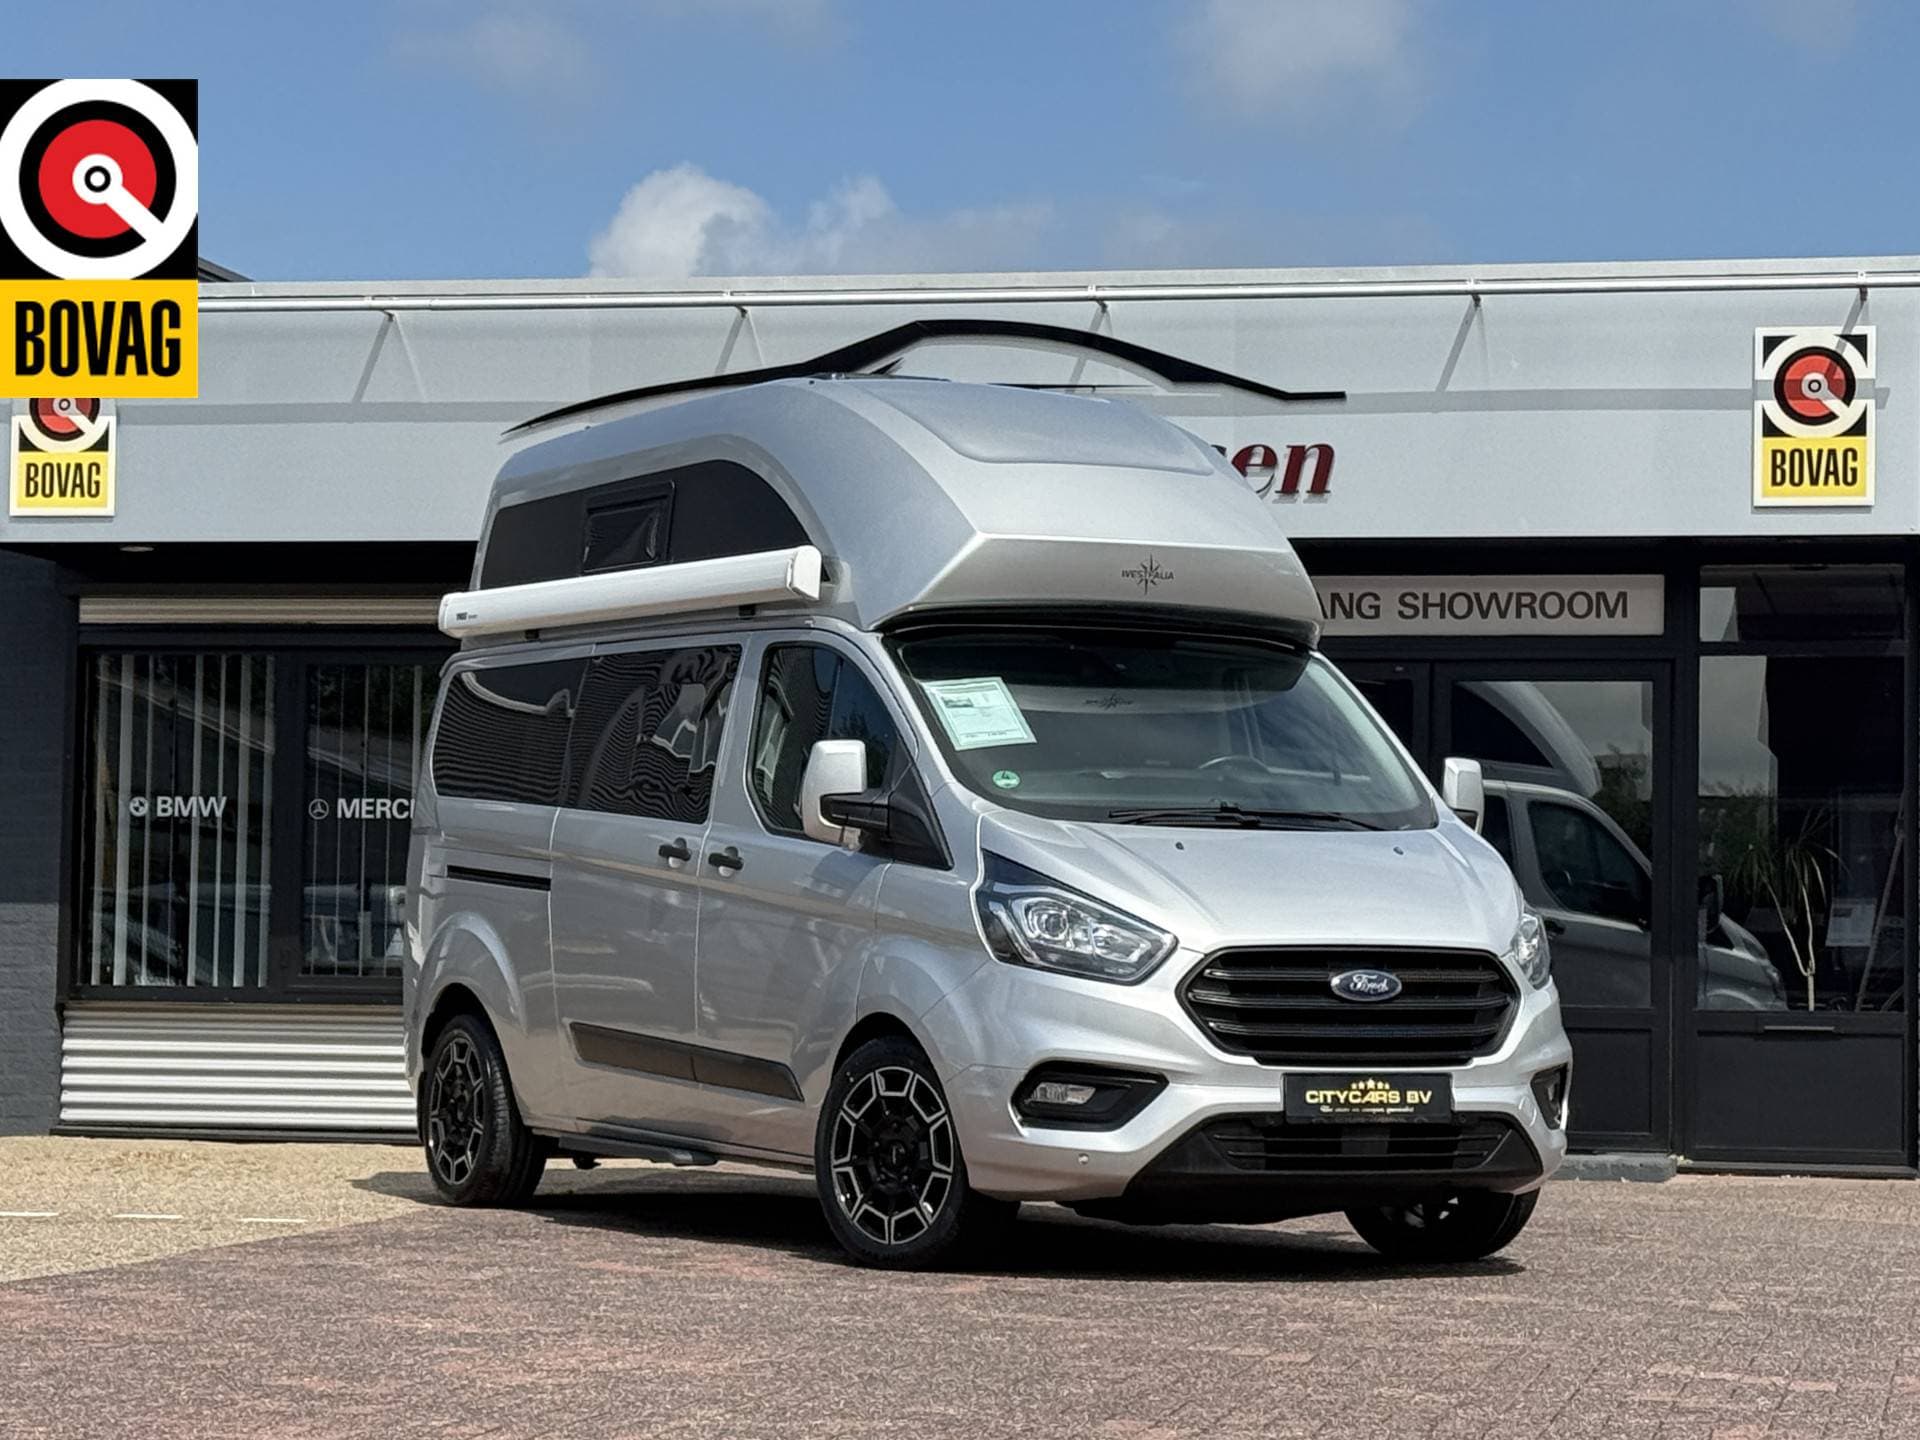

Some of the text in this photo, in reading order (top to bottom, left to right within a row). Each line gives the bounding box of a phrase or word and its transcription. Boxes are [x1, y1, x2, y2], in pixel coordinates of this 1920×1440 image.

[1771, 447, 1858, 487] BOVAG
[25, 462, 101, 498] BOVAG
[1398, 591, 1628, 620] SHOWROOM
[156, 796, 227, 817] BMW
[1350, 974, 1389, 993] Ford
[1305, 1090, 1432, 1104] CITYCARS BV
